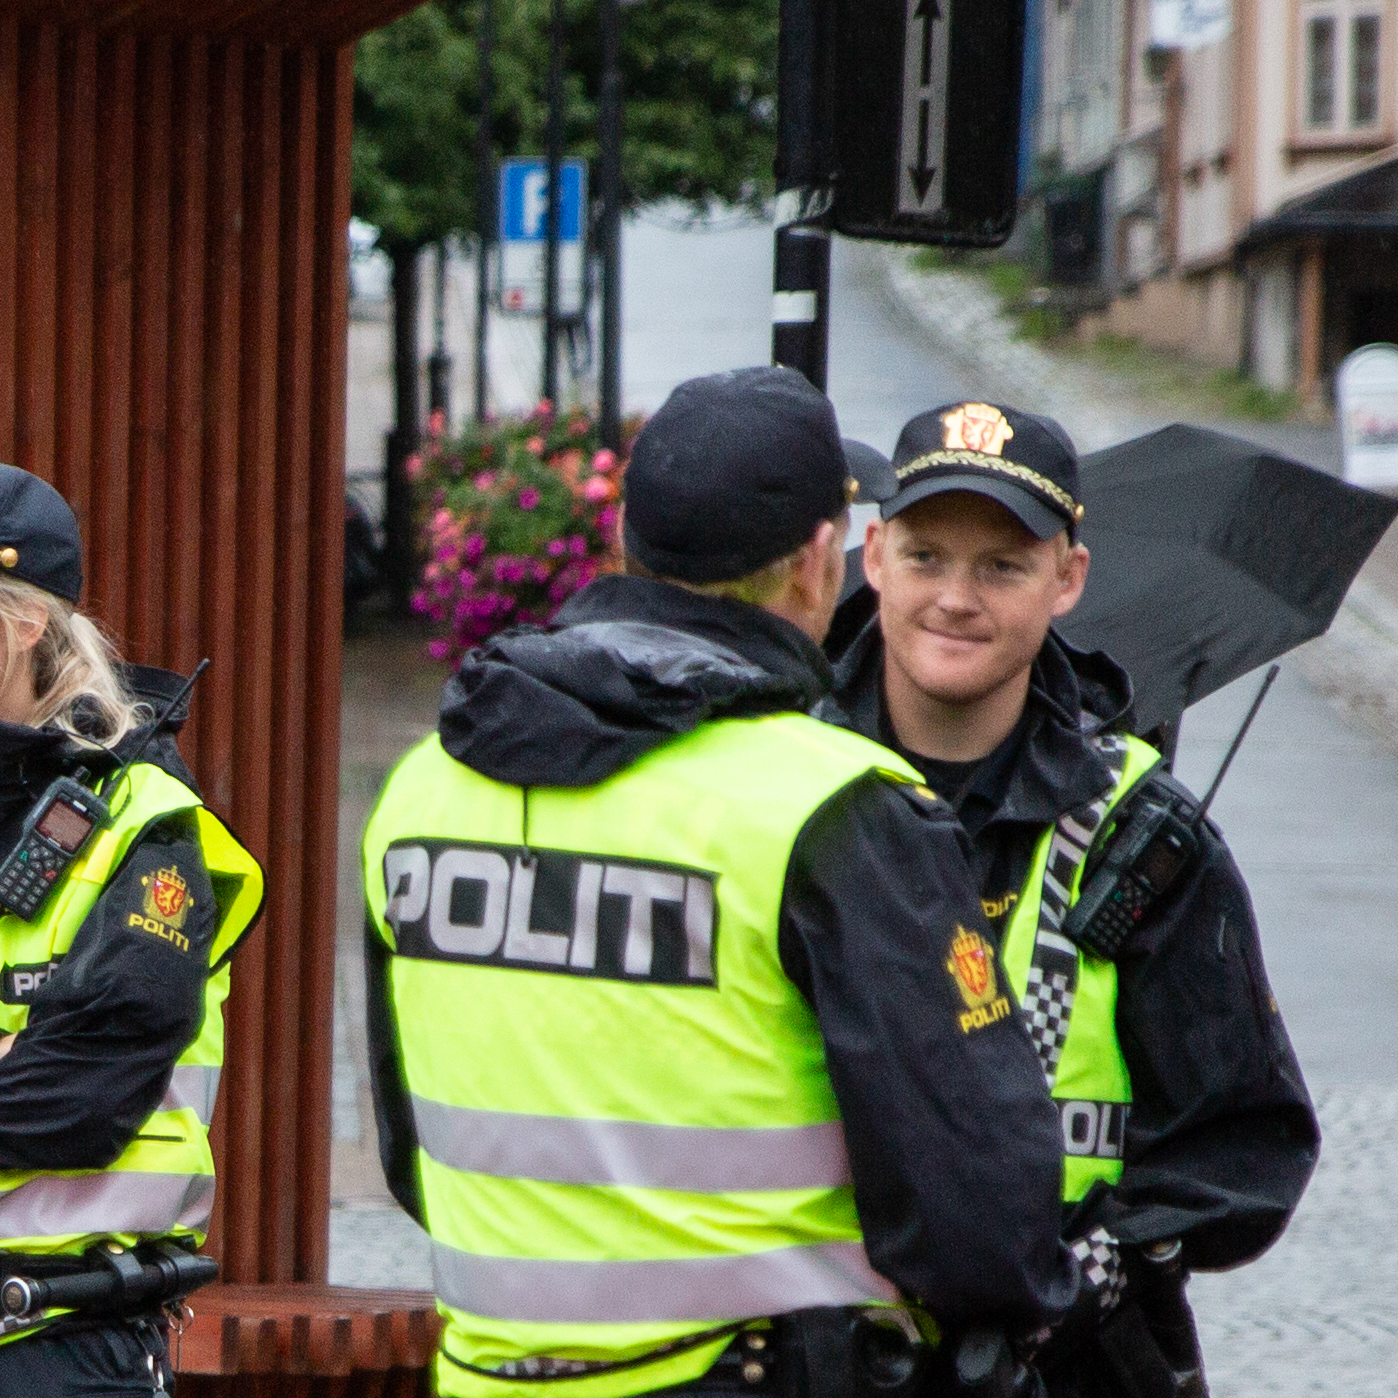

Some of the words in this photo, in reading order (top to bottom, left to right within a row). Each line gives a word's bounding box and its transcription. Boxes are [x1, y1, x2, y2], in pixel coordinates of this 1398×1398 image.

[128, 913, 190, 952] POLITI
[383, 846, 714, 980] POLITI
[959, 997, 1010, 1034] POLITI
